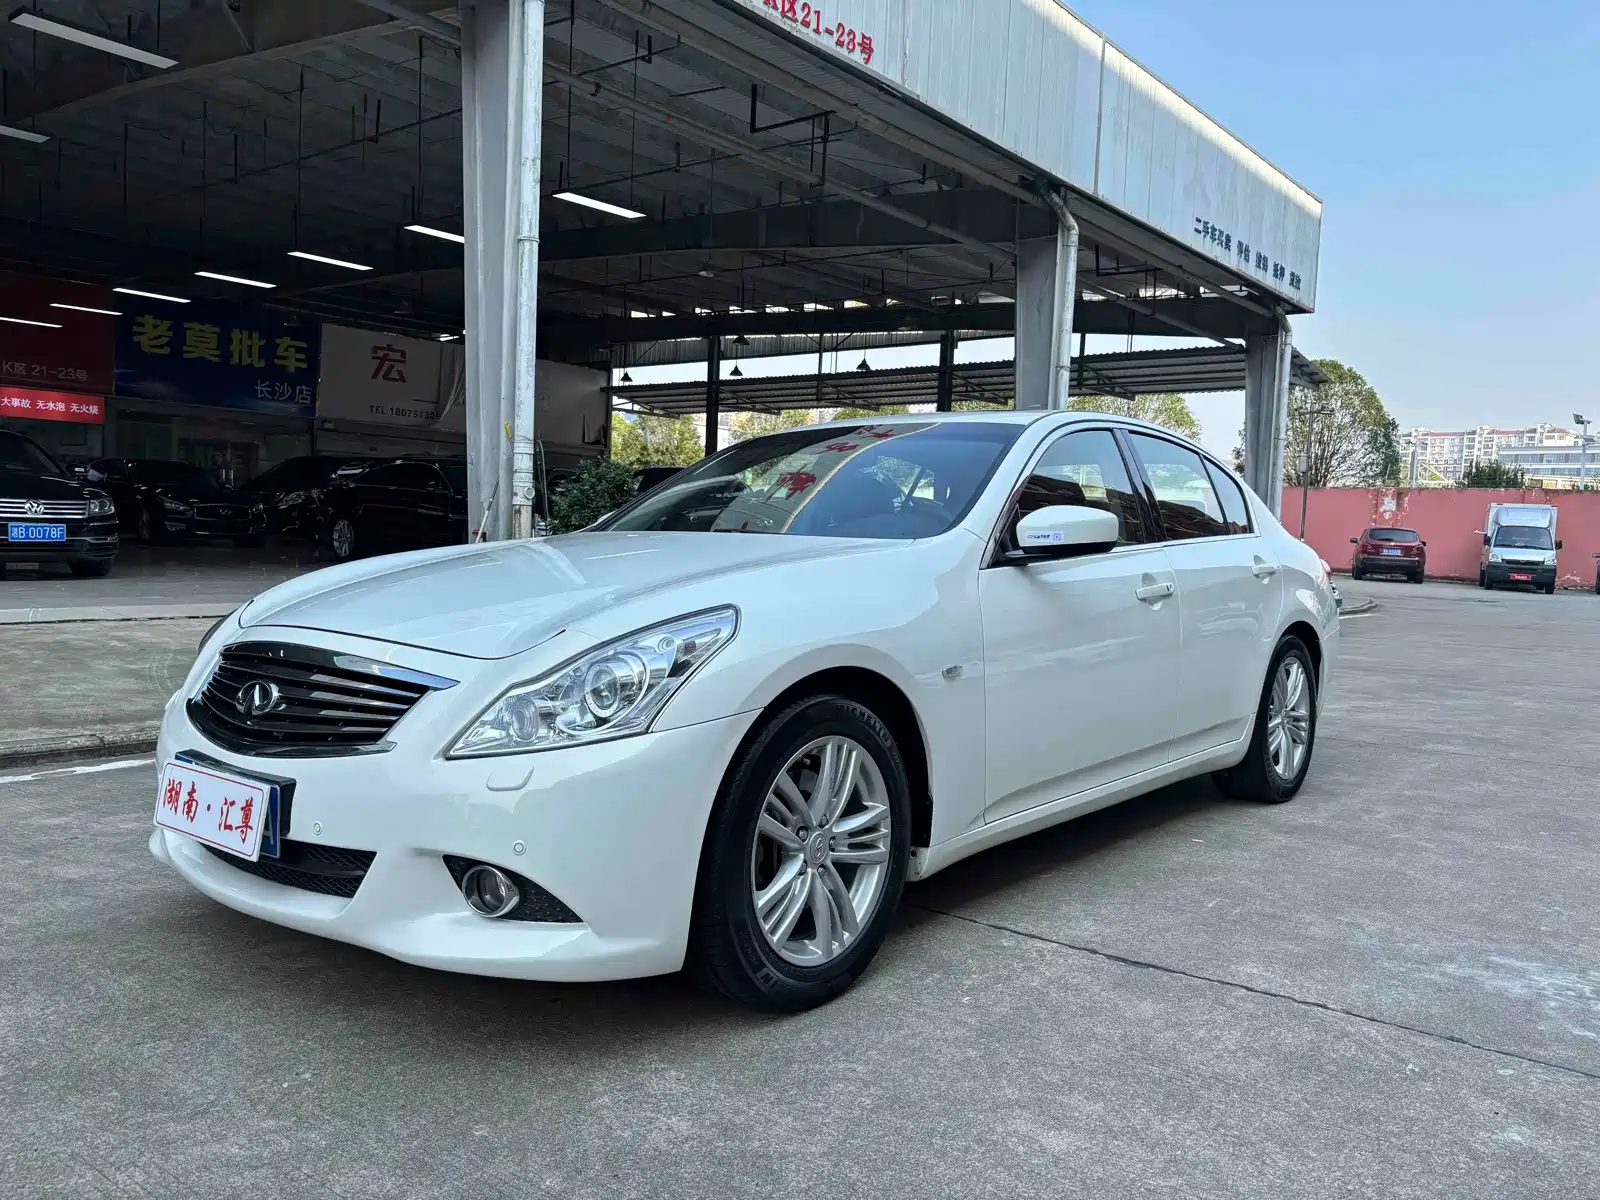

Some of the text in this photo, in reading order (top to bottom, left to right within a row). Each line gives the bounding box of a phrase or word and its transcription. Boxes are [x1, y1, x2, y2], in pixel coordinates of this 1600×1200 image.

[132, 314, 308, 373] 老莫批车
[254, 378, 312, 404] 长沙店
[36, 400, 66, 412] 无水泡
[71, 403, 100, 415] 无火烧
